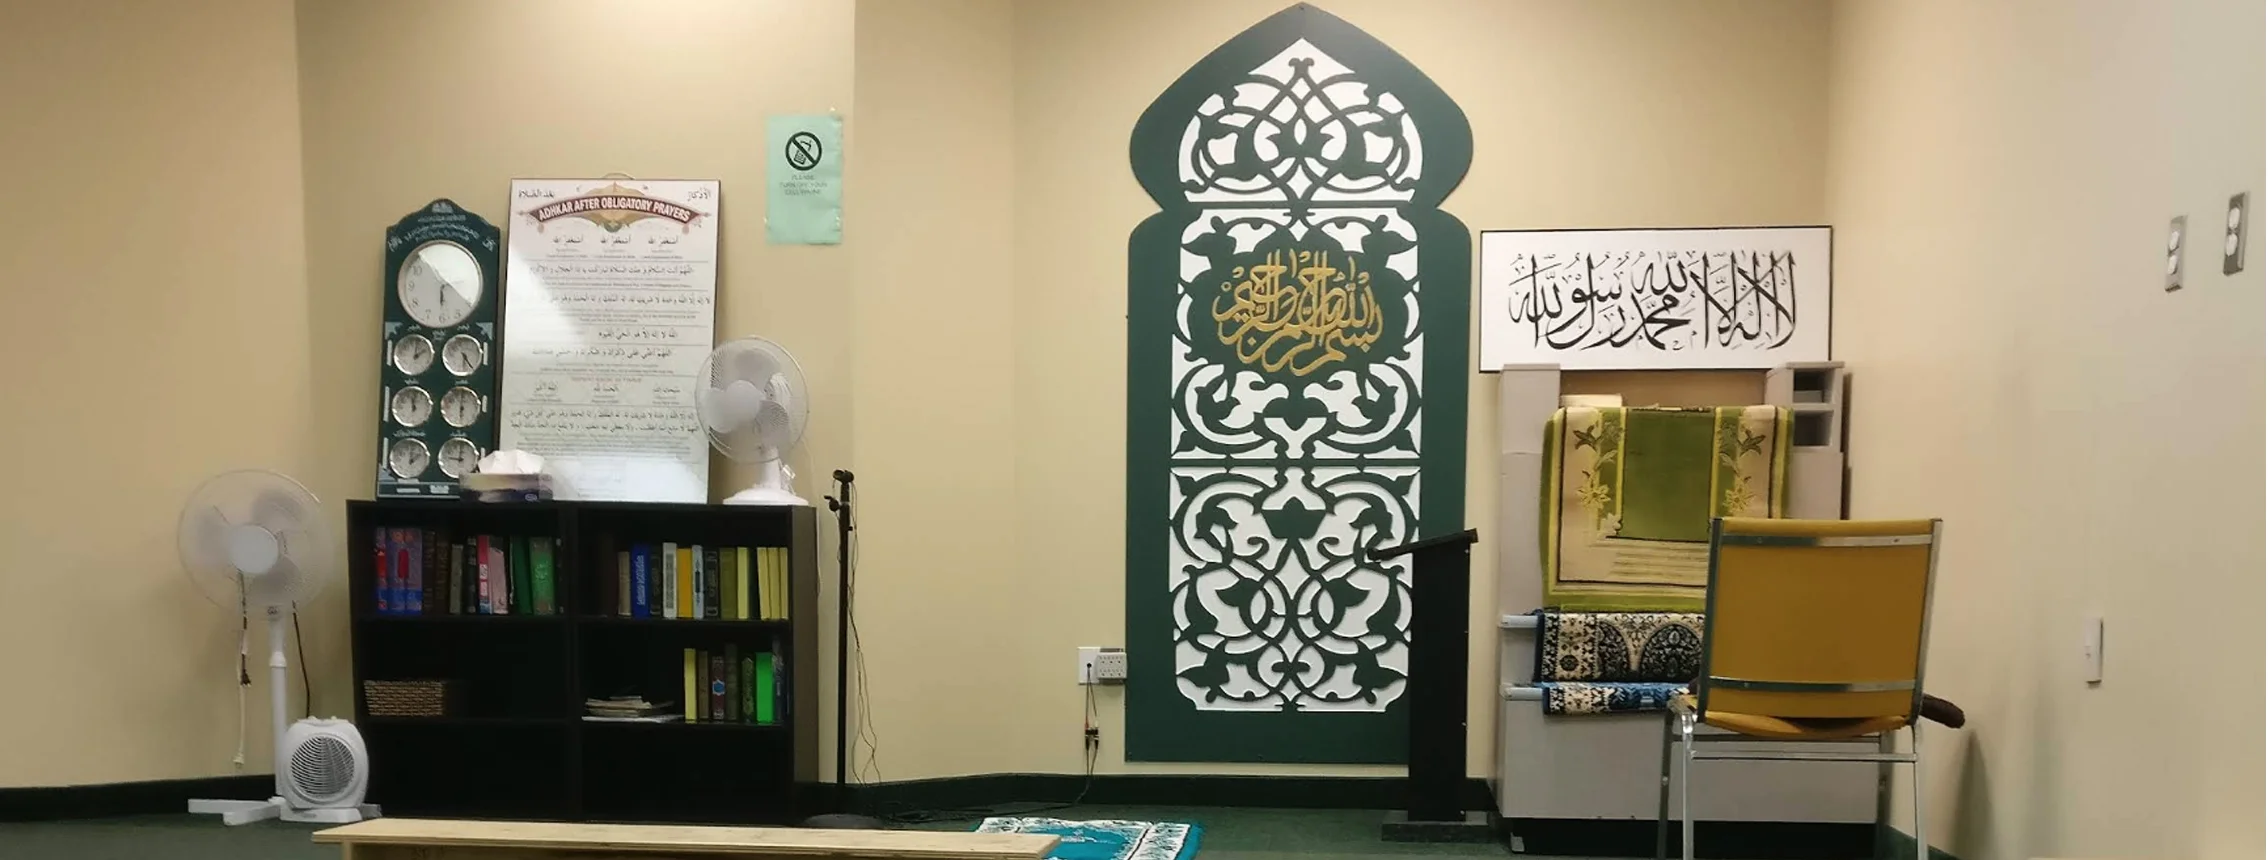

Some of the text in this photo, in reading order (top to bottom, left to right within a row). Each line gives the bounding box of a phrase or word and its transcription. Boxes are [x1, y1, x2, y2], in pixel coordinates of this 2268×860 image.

[539, 196, 691, 223] ADHKAR AFTER OBLIGATORY PRAYERS
